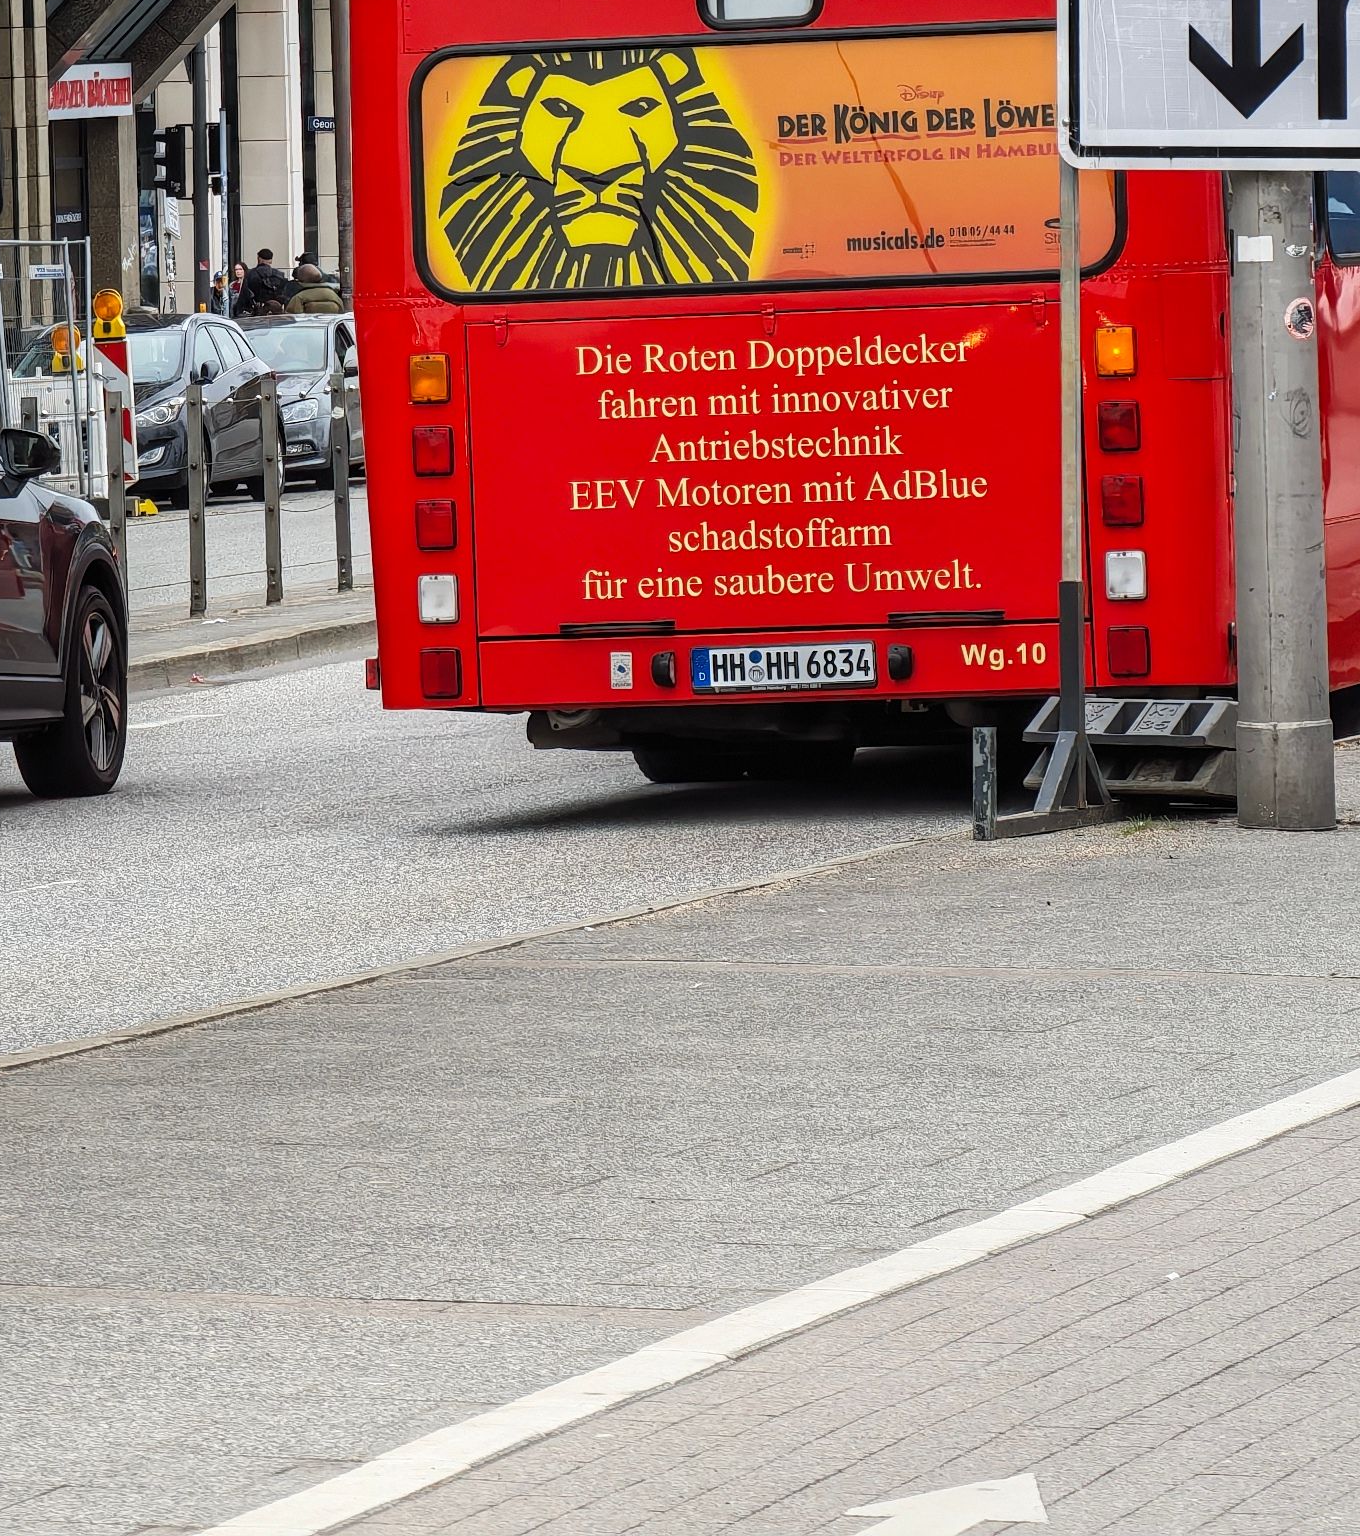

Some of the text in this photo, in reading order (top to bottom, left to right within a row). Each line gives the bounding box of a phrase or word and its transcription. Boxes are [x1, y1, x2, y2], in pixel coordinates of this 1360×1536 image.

[778, 98, 1057, 144] DER KÖNIG DER LÖWE
[977, 143, 1059, 160] HAMBU
[847, 227, 945, 252] musicals.de
[576, 335, 969, 381] Die Roten Doppeldecker
[598, 382, 953, 420] fahren mit innovativer
[650, 425, 904, 464] Antriebstechnik
[570, 468, 988, 512] EEV Motoren mit AdBlue
[668, 518, 893, 553] schadstoffarm
[582, 560, 983, 600] für eine saubere Umwelt.
[712, 653, 746, 682] HH
[766, 651, 800, 680] HH
[807, 648, 871, 679] 6834
[960, 642, 1047, 671] Wg.10
